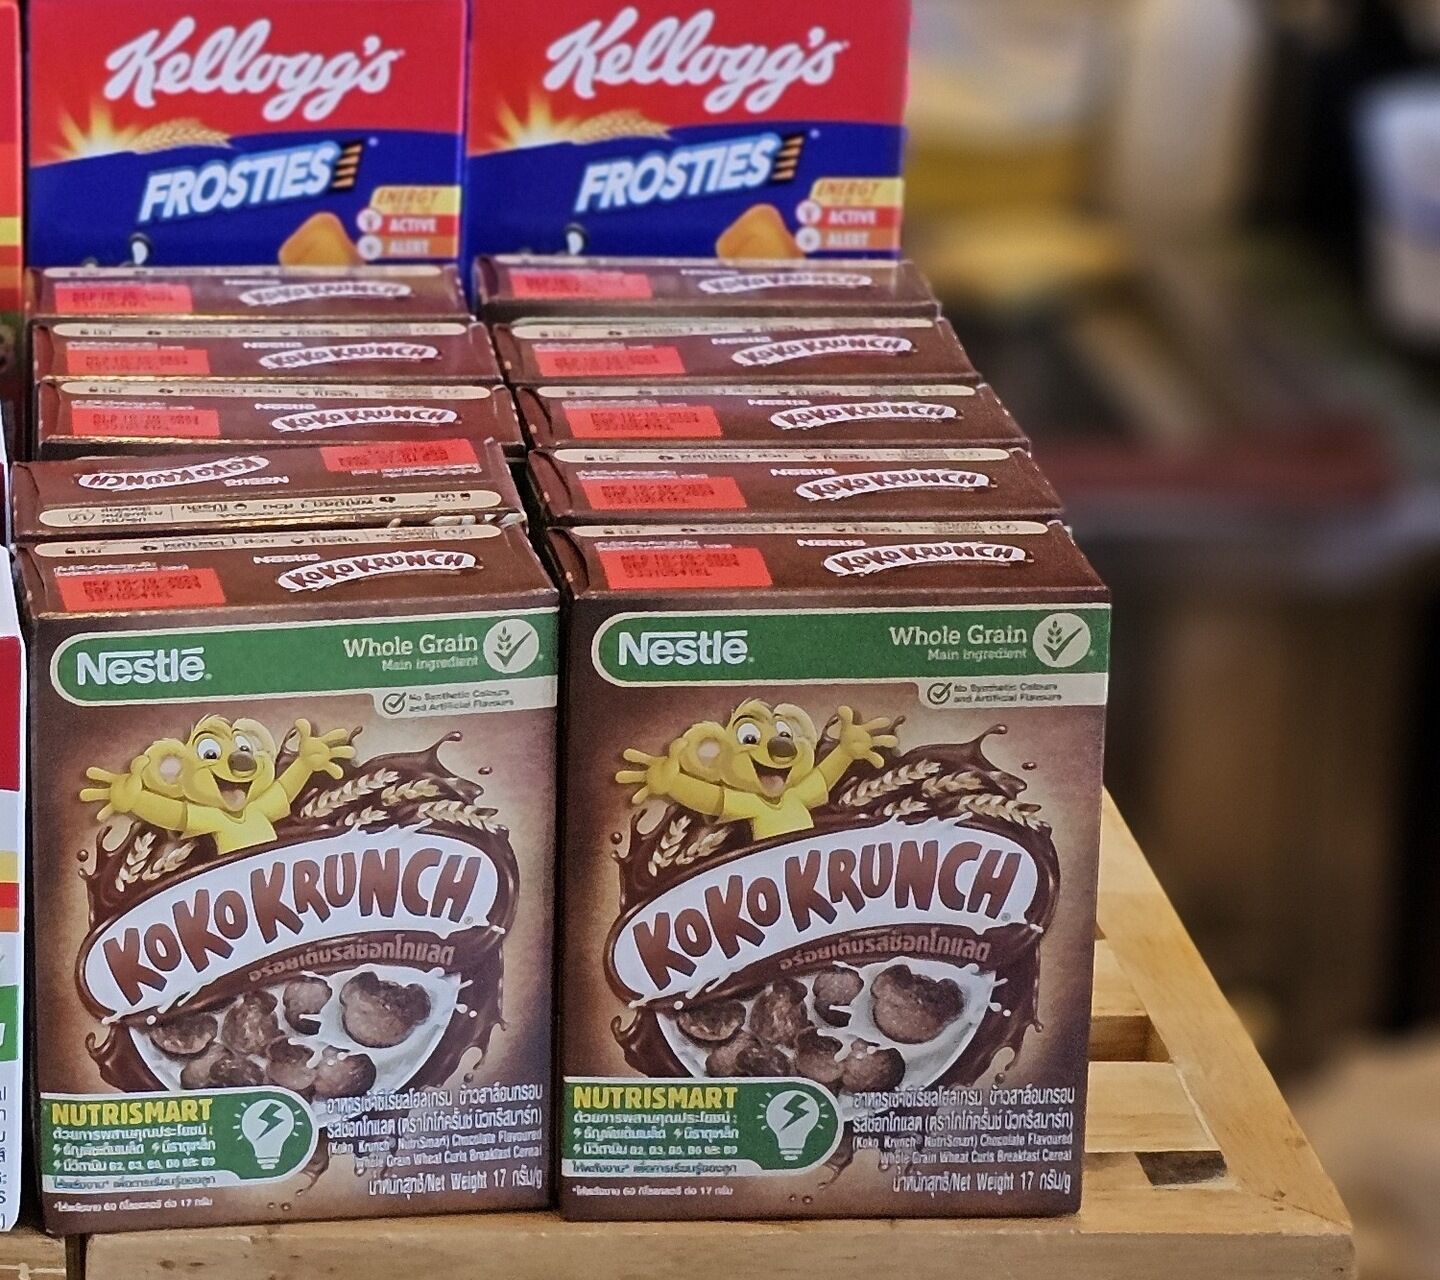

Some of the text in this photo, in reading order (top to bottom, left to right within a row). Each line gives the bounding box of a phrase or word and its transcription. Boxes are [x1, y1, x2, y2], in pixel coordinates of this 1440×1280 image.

[105, 16, 401, 121] Kellogg's
[545, 7, 838, 112] Kellogg's
[138, 142, 337, 222] FROSTIES
[574, 135, 776, 212] FROSTIES
[389, 218, 437, 232] ACTIVE
[829, 210, 876, 224] ACTIVE
[389, 240, 429, 254] ALERT
[827, 233, 869, 246] ALERT
[282, 409, 447, 428] KOKO KRUNCH
[806, 473, 977, 497] KOKO KRUNCH
[832, 545, 1014, 571] KOKO KRUNCH
[286, 554, 464, 588] KOKO KRUNCH
[343, 634, 478, 658] Whole Grain
[889, 624, 1027, 645] Whole Grain
[617, 629, 749, 666] Nestlé
[927, 648, 1027, 662] Main Ingredient
[77, 647, 206, 686] Nestlé
[382, 659, 412, 671] Main
[103, 847, 483, 1006] KOKO KRUNCH
[633, 840, 1023, 992] KOKO KRUNCH
[573, 1086, 738, 1109] NUTRISMART
[52, 1098, 212, 1126] NUTRISMART
[451, 1168, 506, 1193] Weight 17
[976, 1171, 1034, 1195] Weight 17
